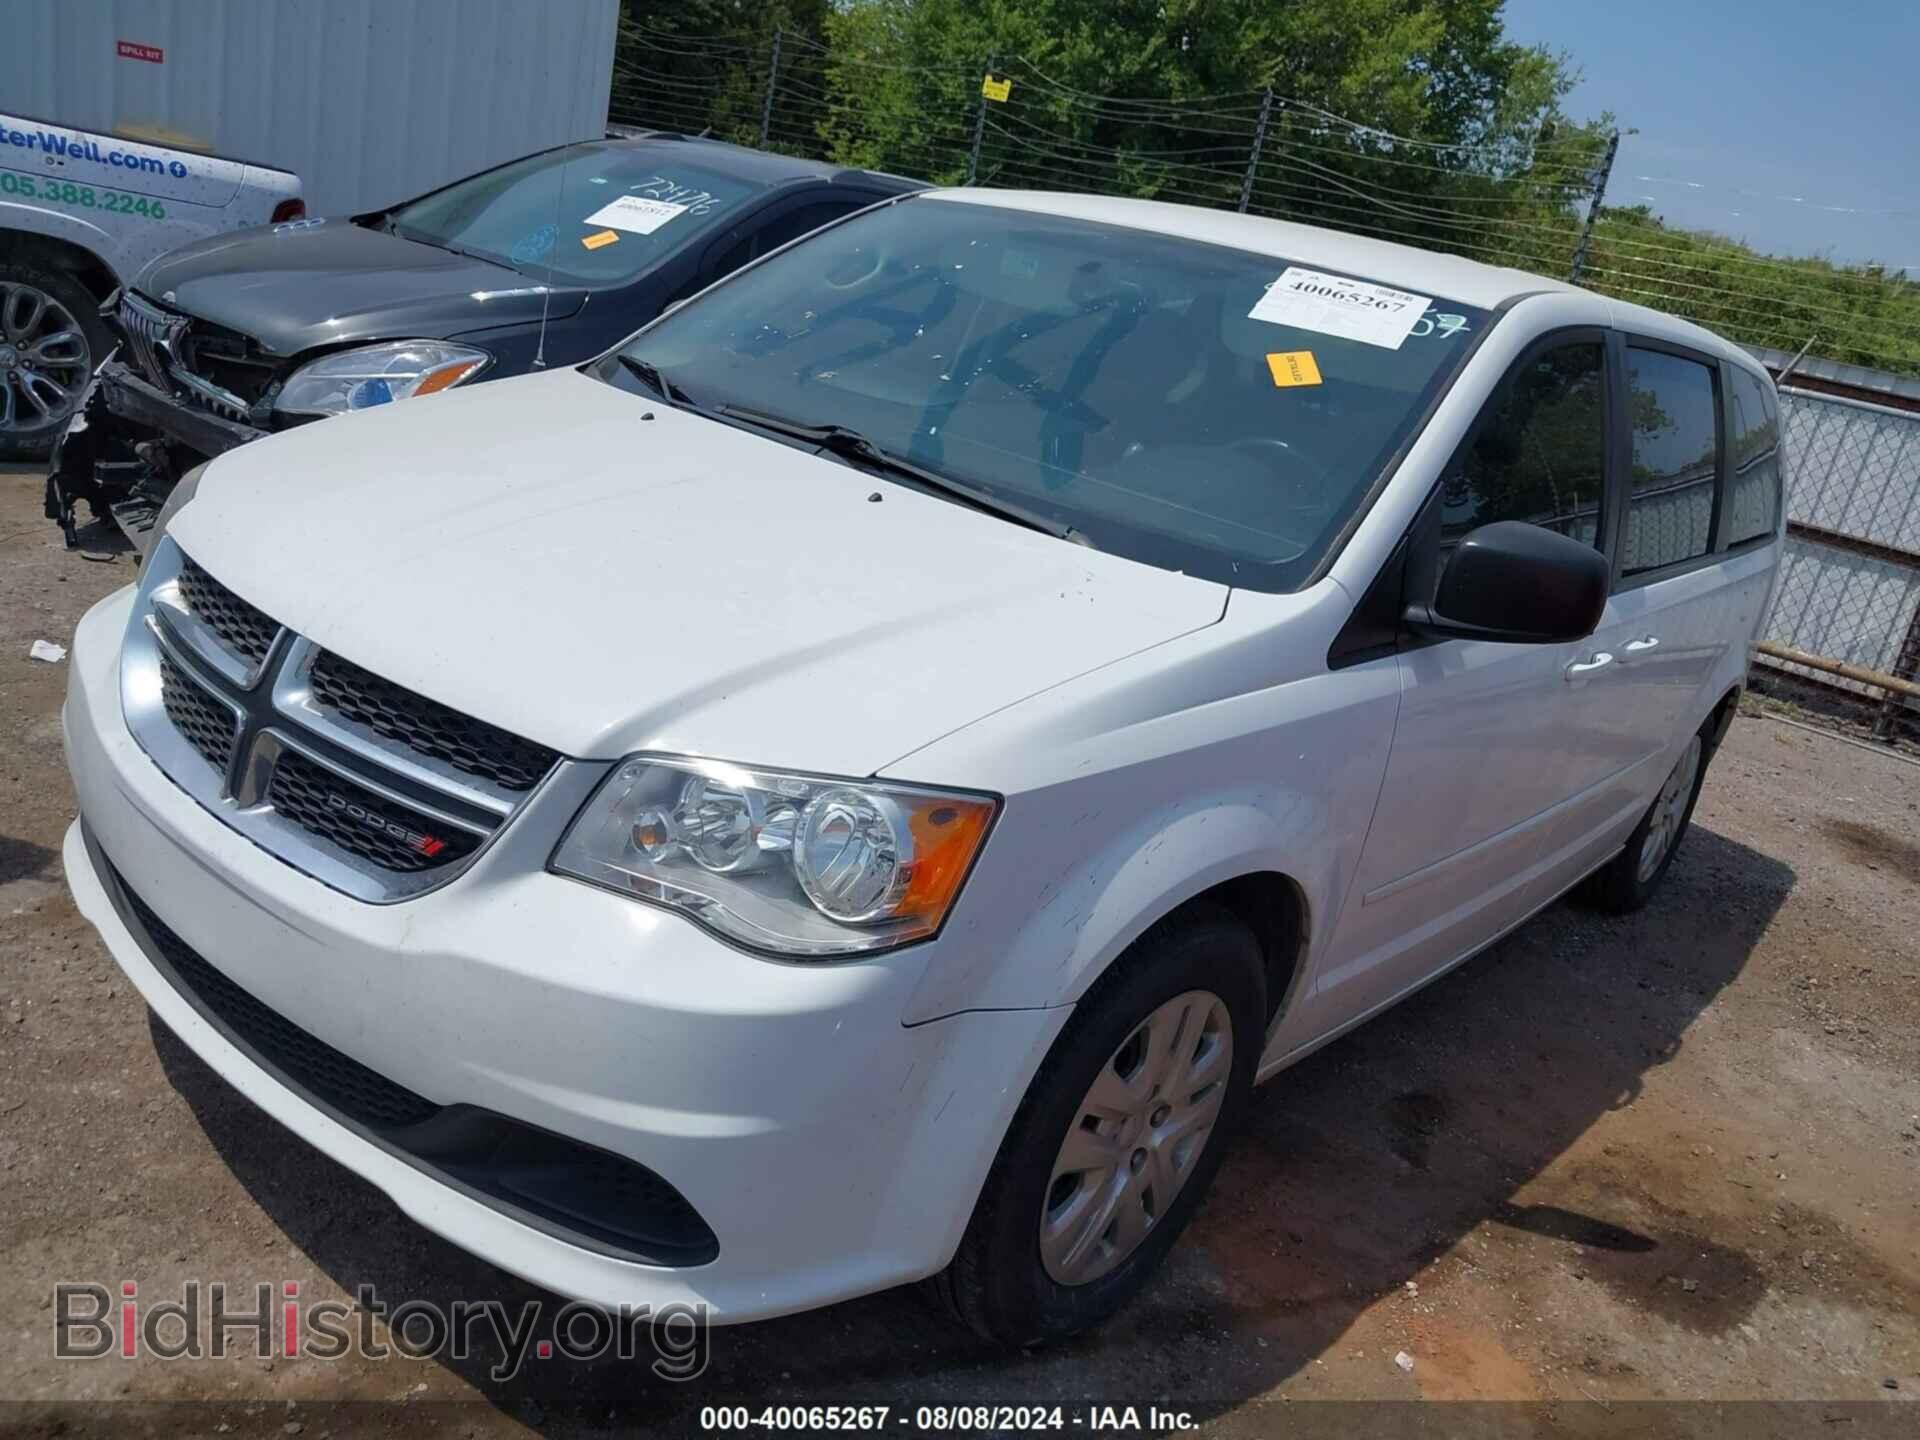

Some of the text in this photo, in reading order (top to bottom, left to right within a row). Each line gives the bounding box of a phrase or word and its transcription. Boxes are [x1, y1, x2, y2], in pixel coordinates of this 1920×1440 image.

[0, 172, 166, 219] 05.388.2246
[1289, 281, 1405, 313] 40065267
[326, 791, 427, 850] DODGE
